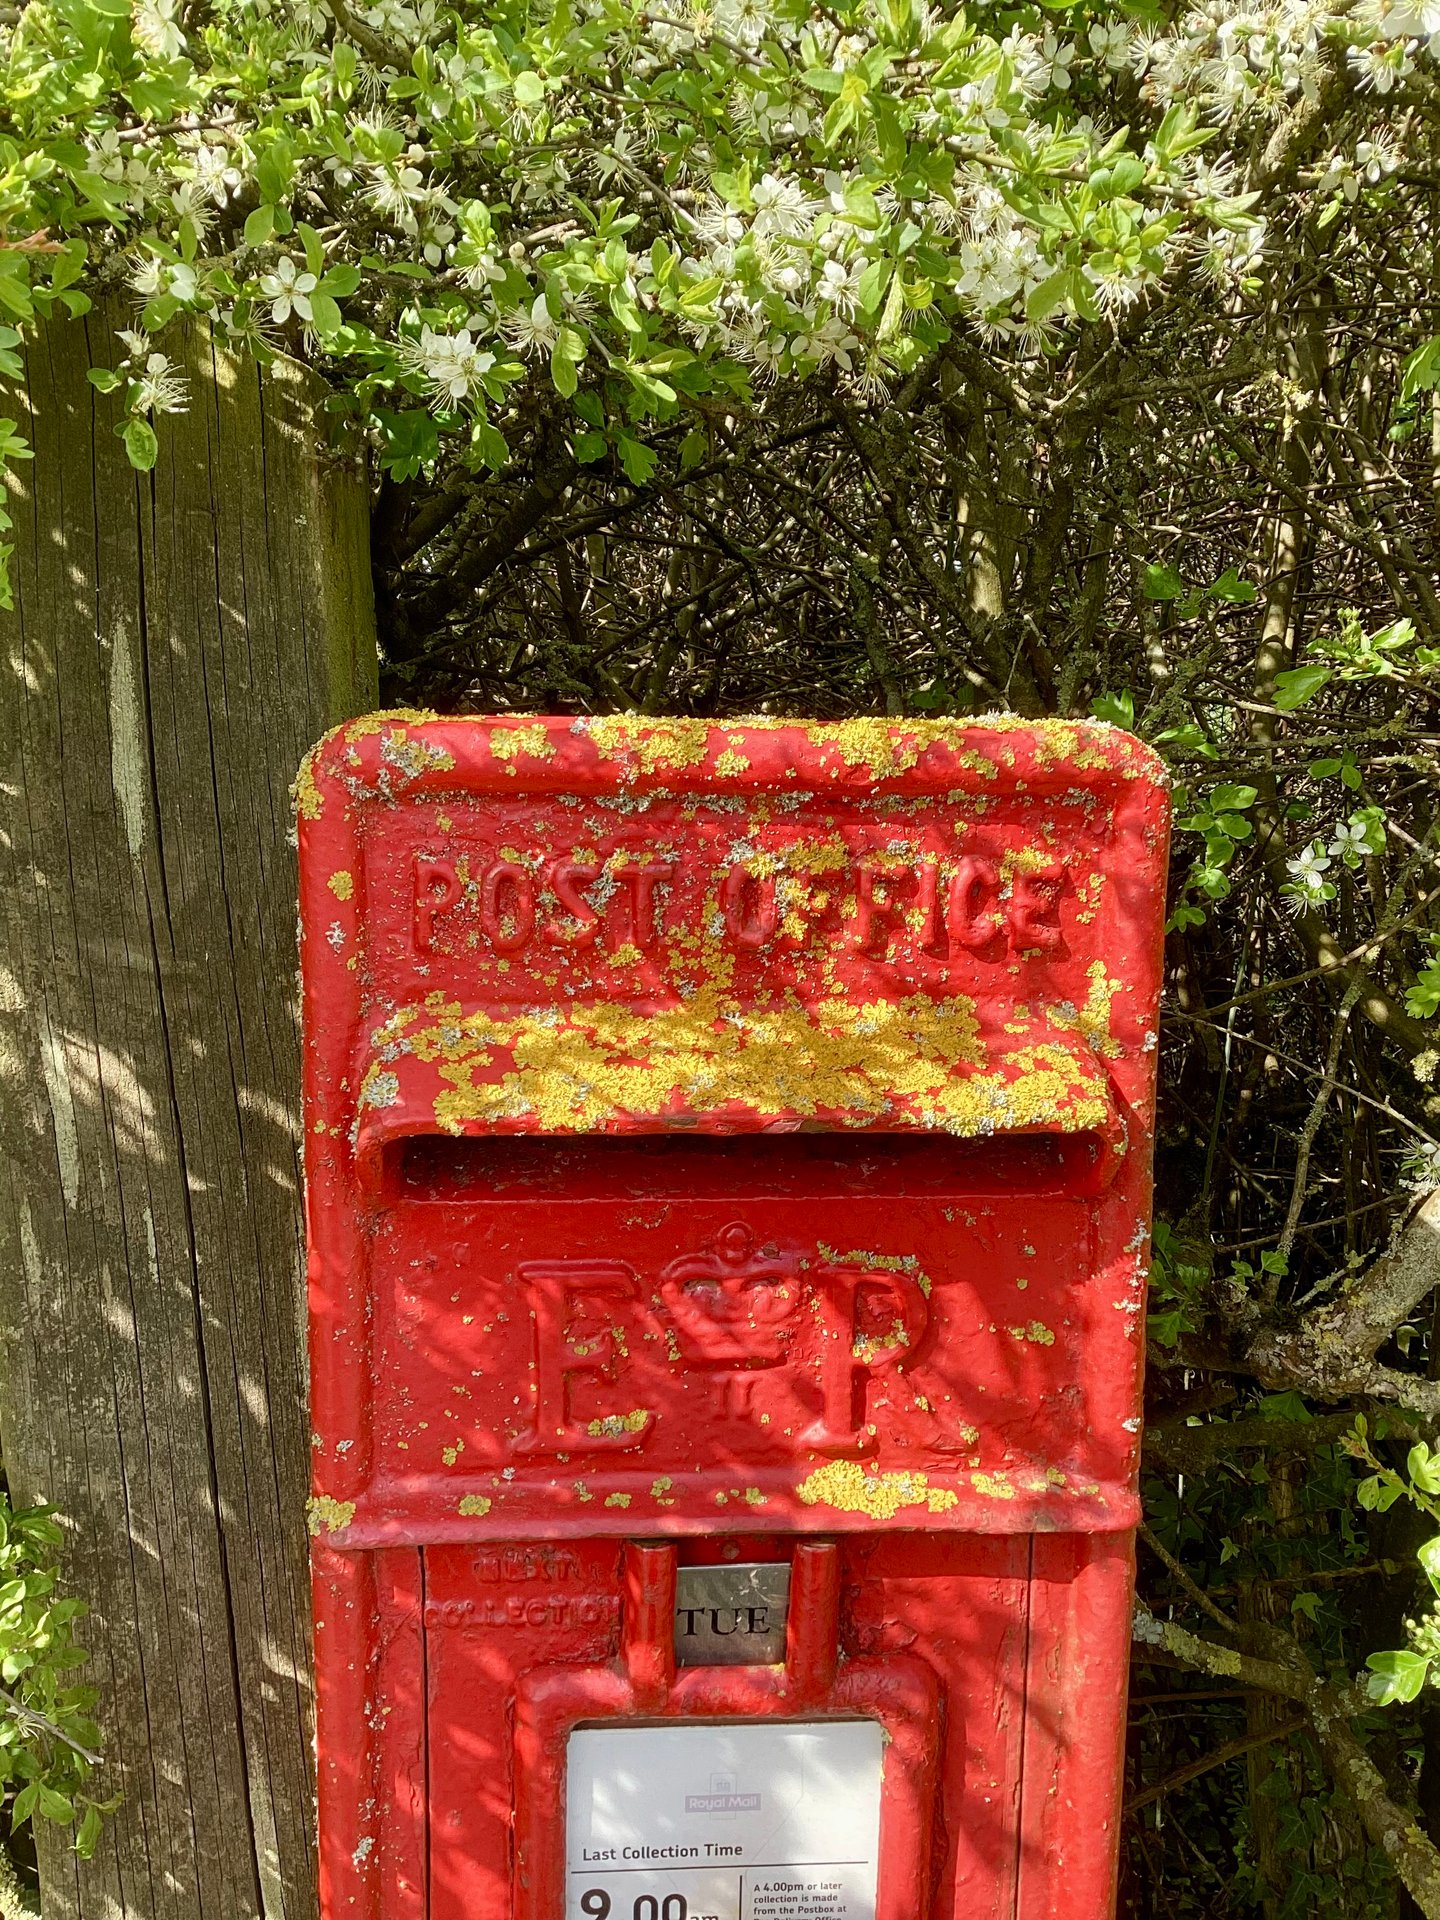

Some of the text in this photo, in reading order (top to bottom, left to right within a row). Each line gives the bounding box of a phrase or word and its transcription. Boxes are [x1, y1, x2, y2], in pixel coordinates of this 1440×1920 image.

[411, 851, 1069, 953] POST OFFICE
[677, 1606, 771, 1637] TUE
[689, 1796, 757, 1811] Royal Mail
[583, 1843, 743, 1861] Last Collection Time
[753, 1884, 761, 1892] A
[763, 1882, 804, 1893] 4.00pm
[820, 1882, 842, 1890] later
[753, 1893, 838, 1904] collection is made
[753, 1906, 776, 1915] from
[779, 1906, 795, 1915] the
[797, 1905, 834, 1914] Postbox
